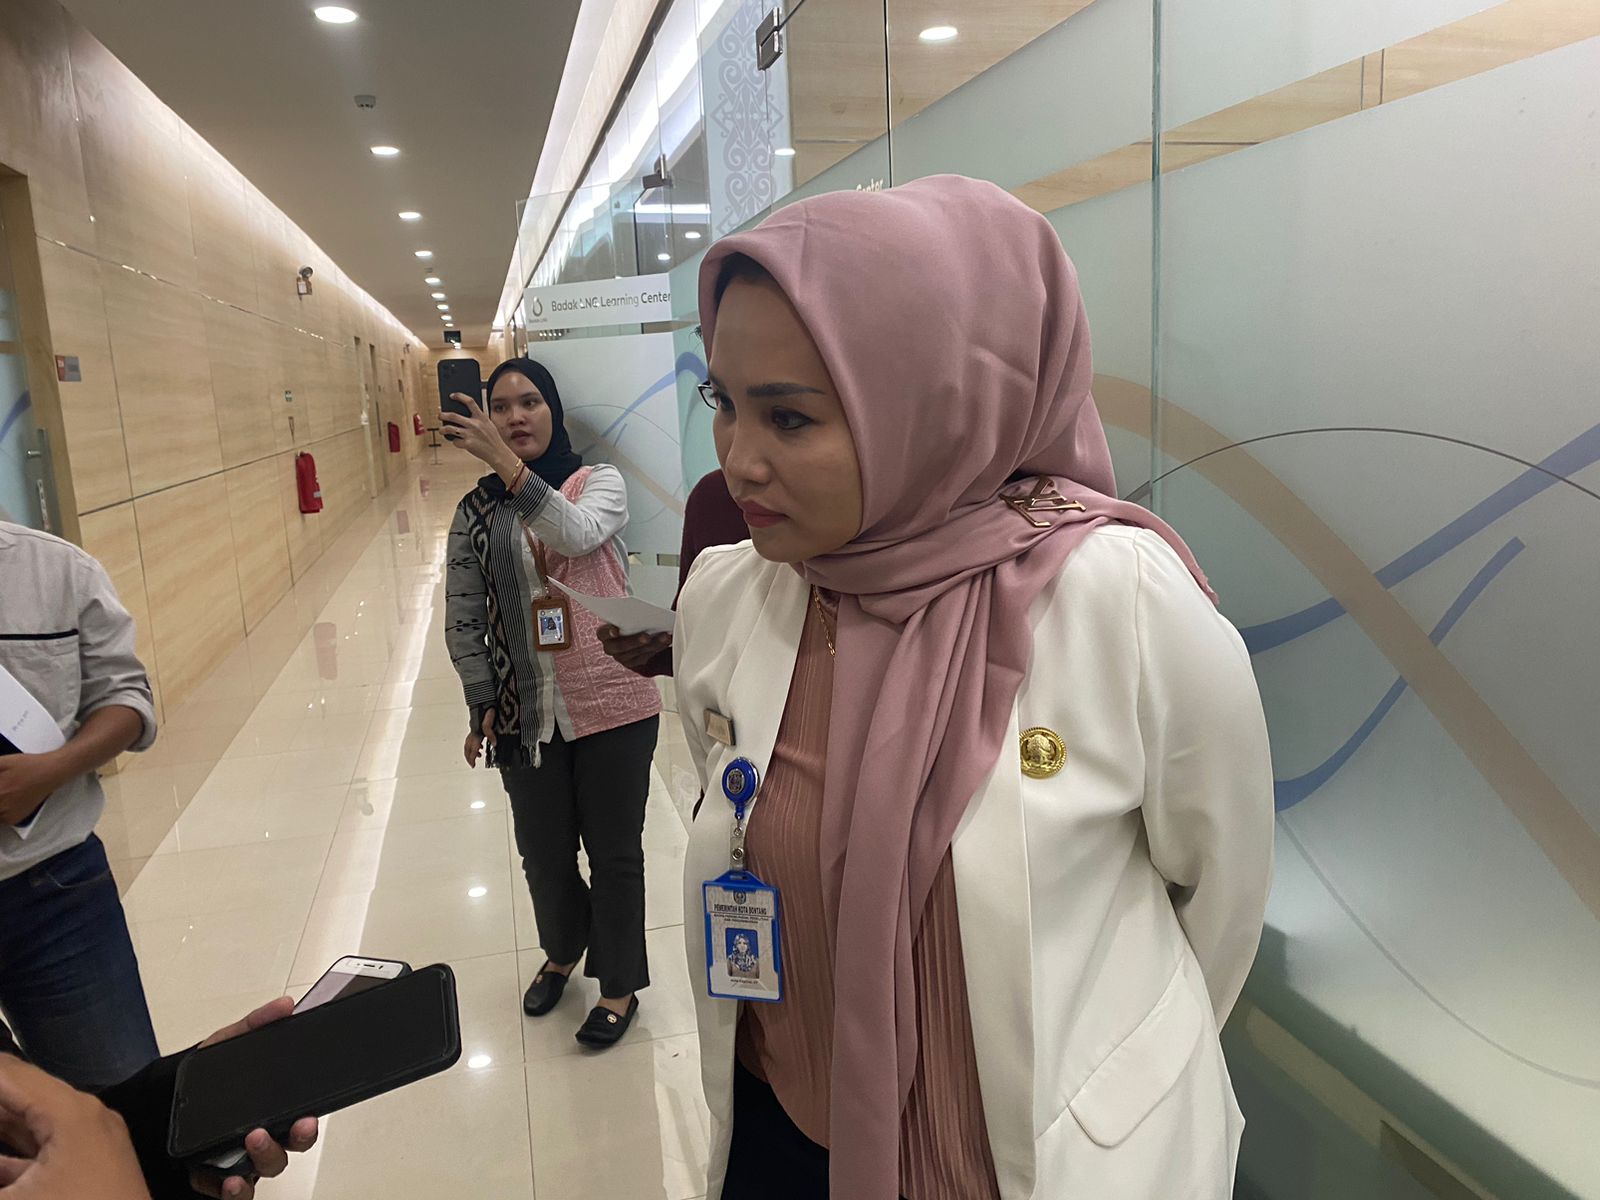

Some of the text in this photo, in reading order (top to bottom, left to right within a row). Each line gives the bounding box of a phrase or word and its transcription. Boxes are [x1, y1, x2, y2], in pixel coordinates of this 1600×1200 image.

[551, 299, 578, 312] Badak
[600, 293, 639, 308] Learning
[640, 292, 671, 304] Center
[738, 905, 748, 913] KOTA
[749, 906, 767, 915] BONTANG
